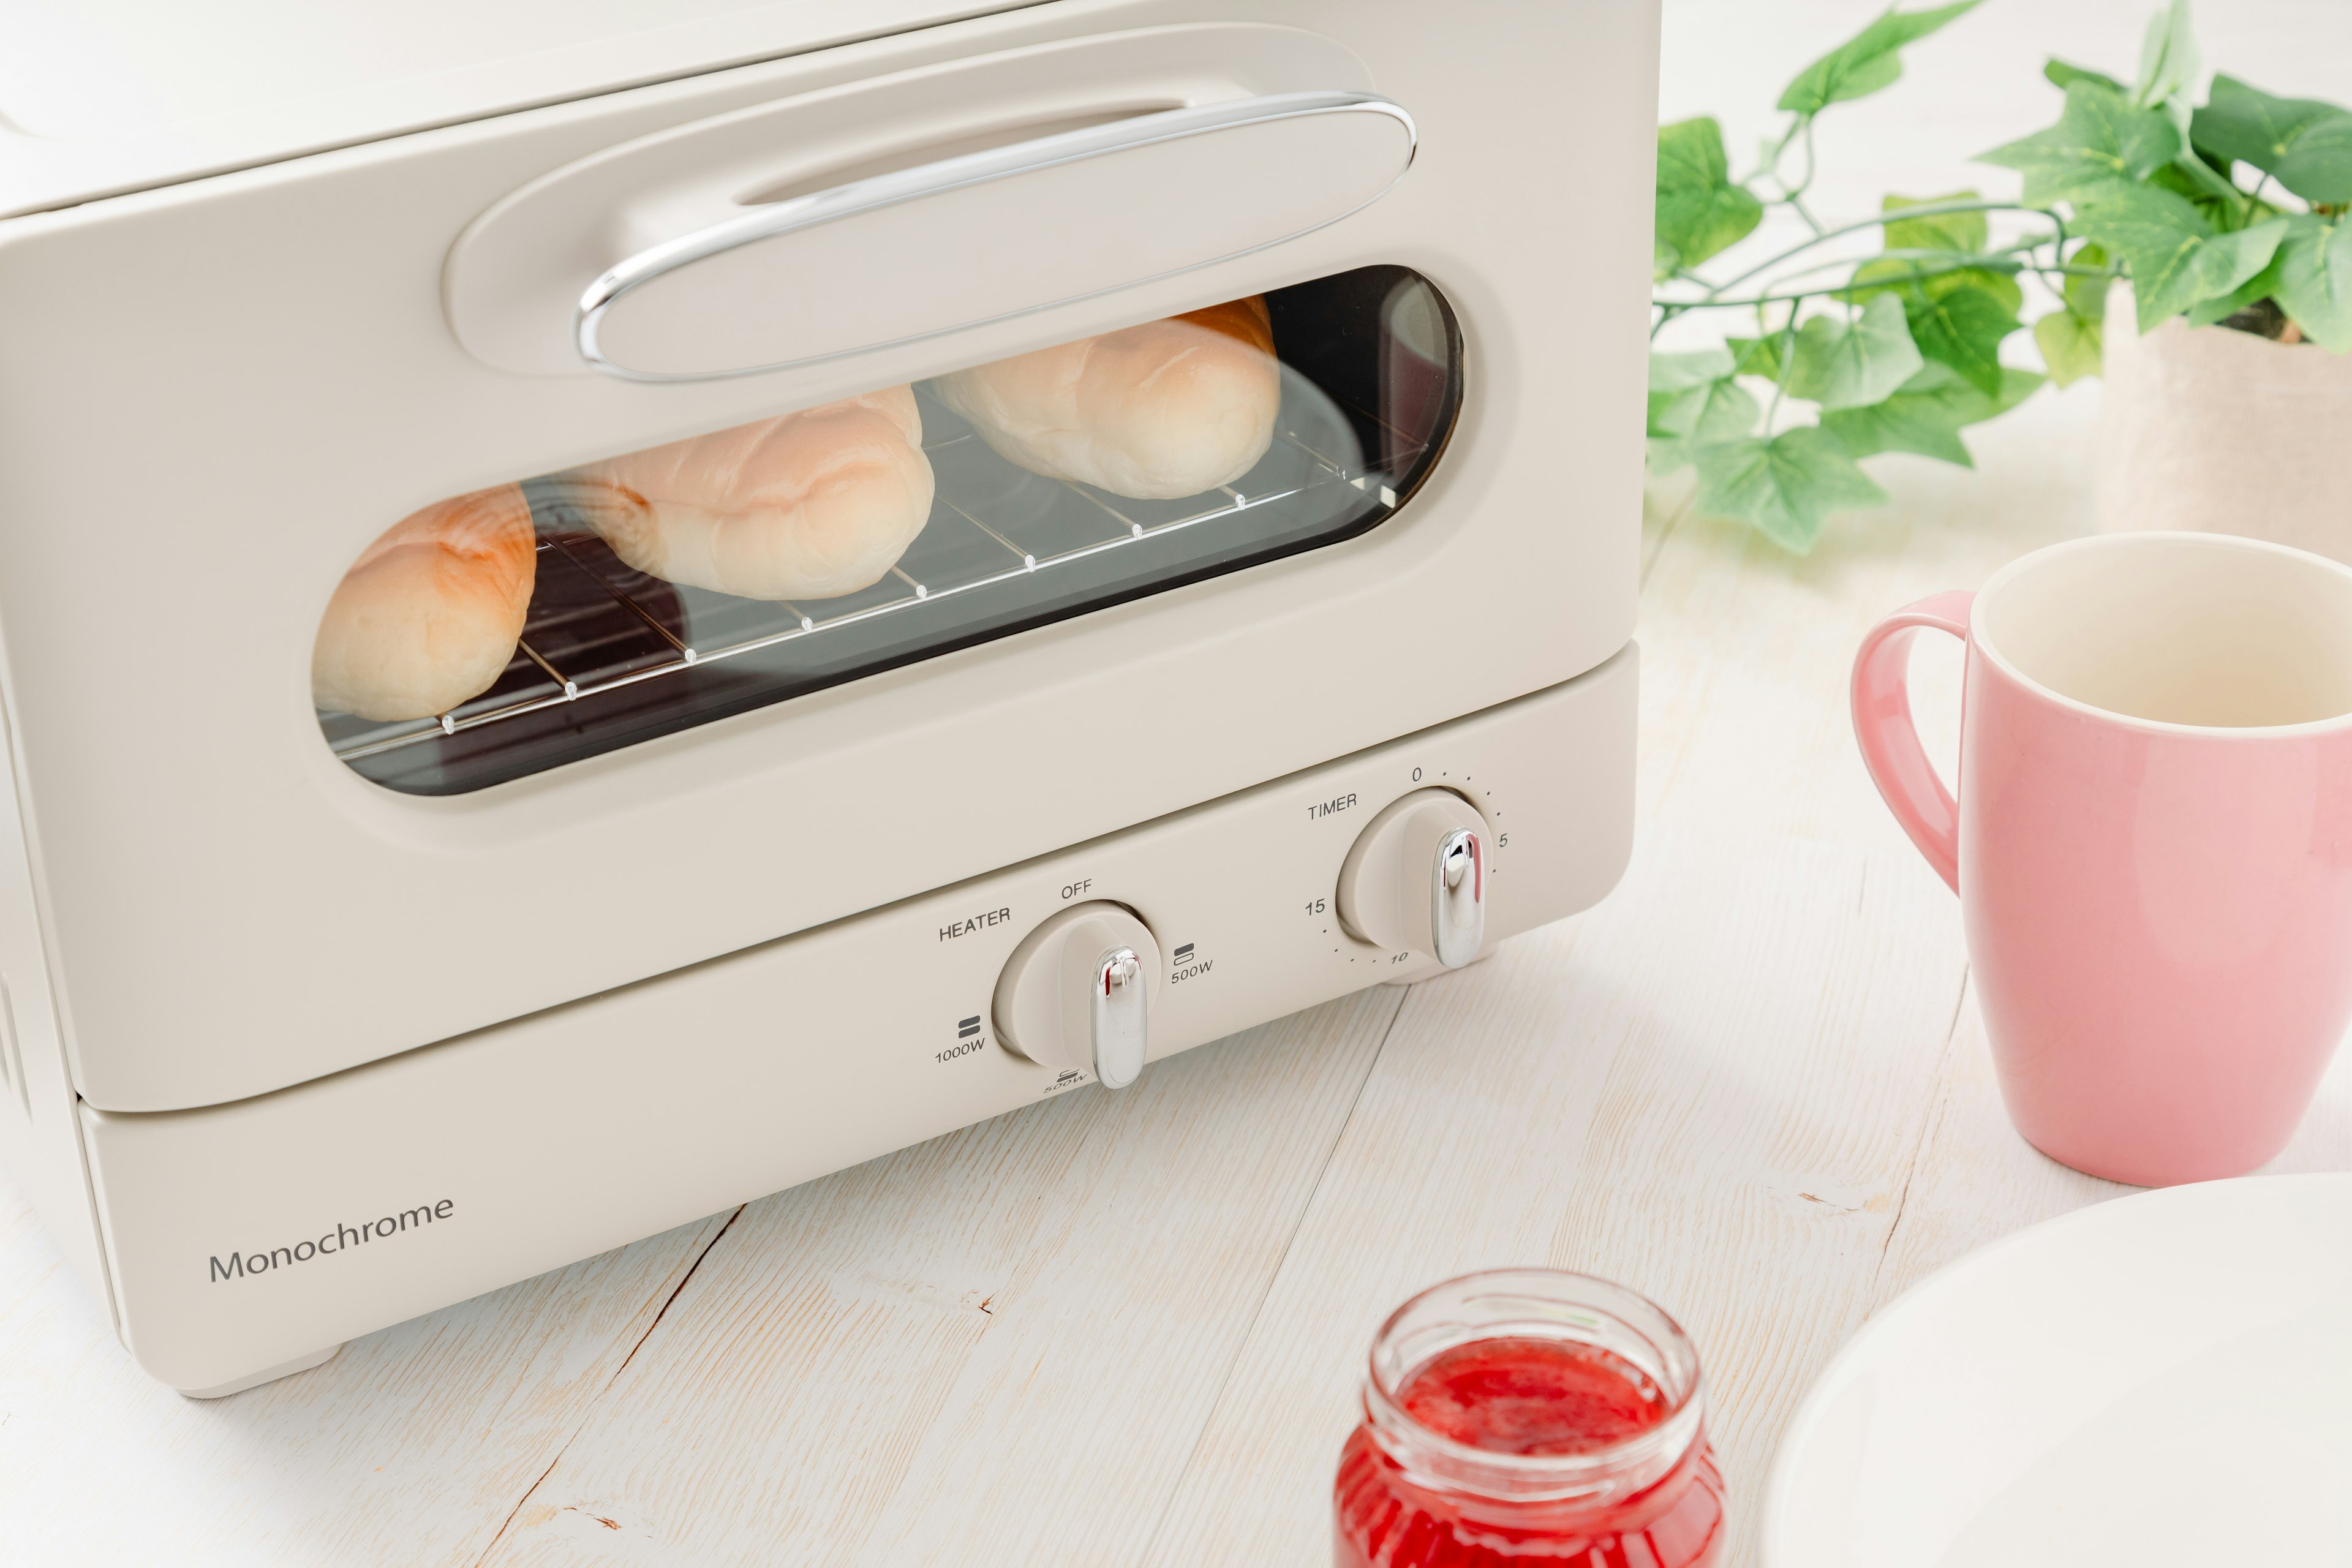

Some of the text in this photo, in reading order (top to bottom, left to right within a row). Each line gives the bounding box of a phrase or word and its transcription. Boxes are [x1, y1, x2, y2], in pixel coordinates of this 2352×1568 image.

[1412, 767, 1422, 782] 0
[1307, 793, 1357, 821] TIMER
[1499, 832, 1508, 848] 5
[1061, 878, 1091, 900] OFF
[1305, 898, 1325, 916] 15
[939, 907, 1011, 942] HEATER
[1391, 951, 1409, 965] 10
[1170, 959, 1213, 984] 500W
[934, 1037, 986, 1064] 1000W
[1043, 1073, 1088, 1094] 500W
[209, 1199, 454, 1283] Monochrome
